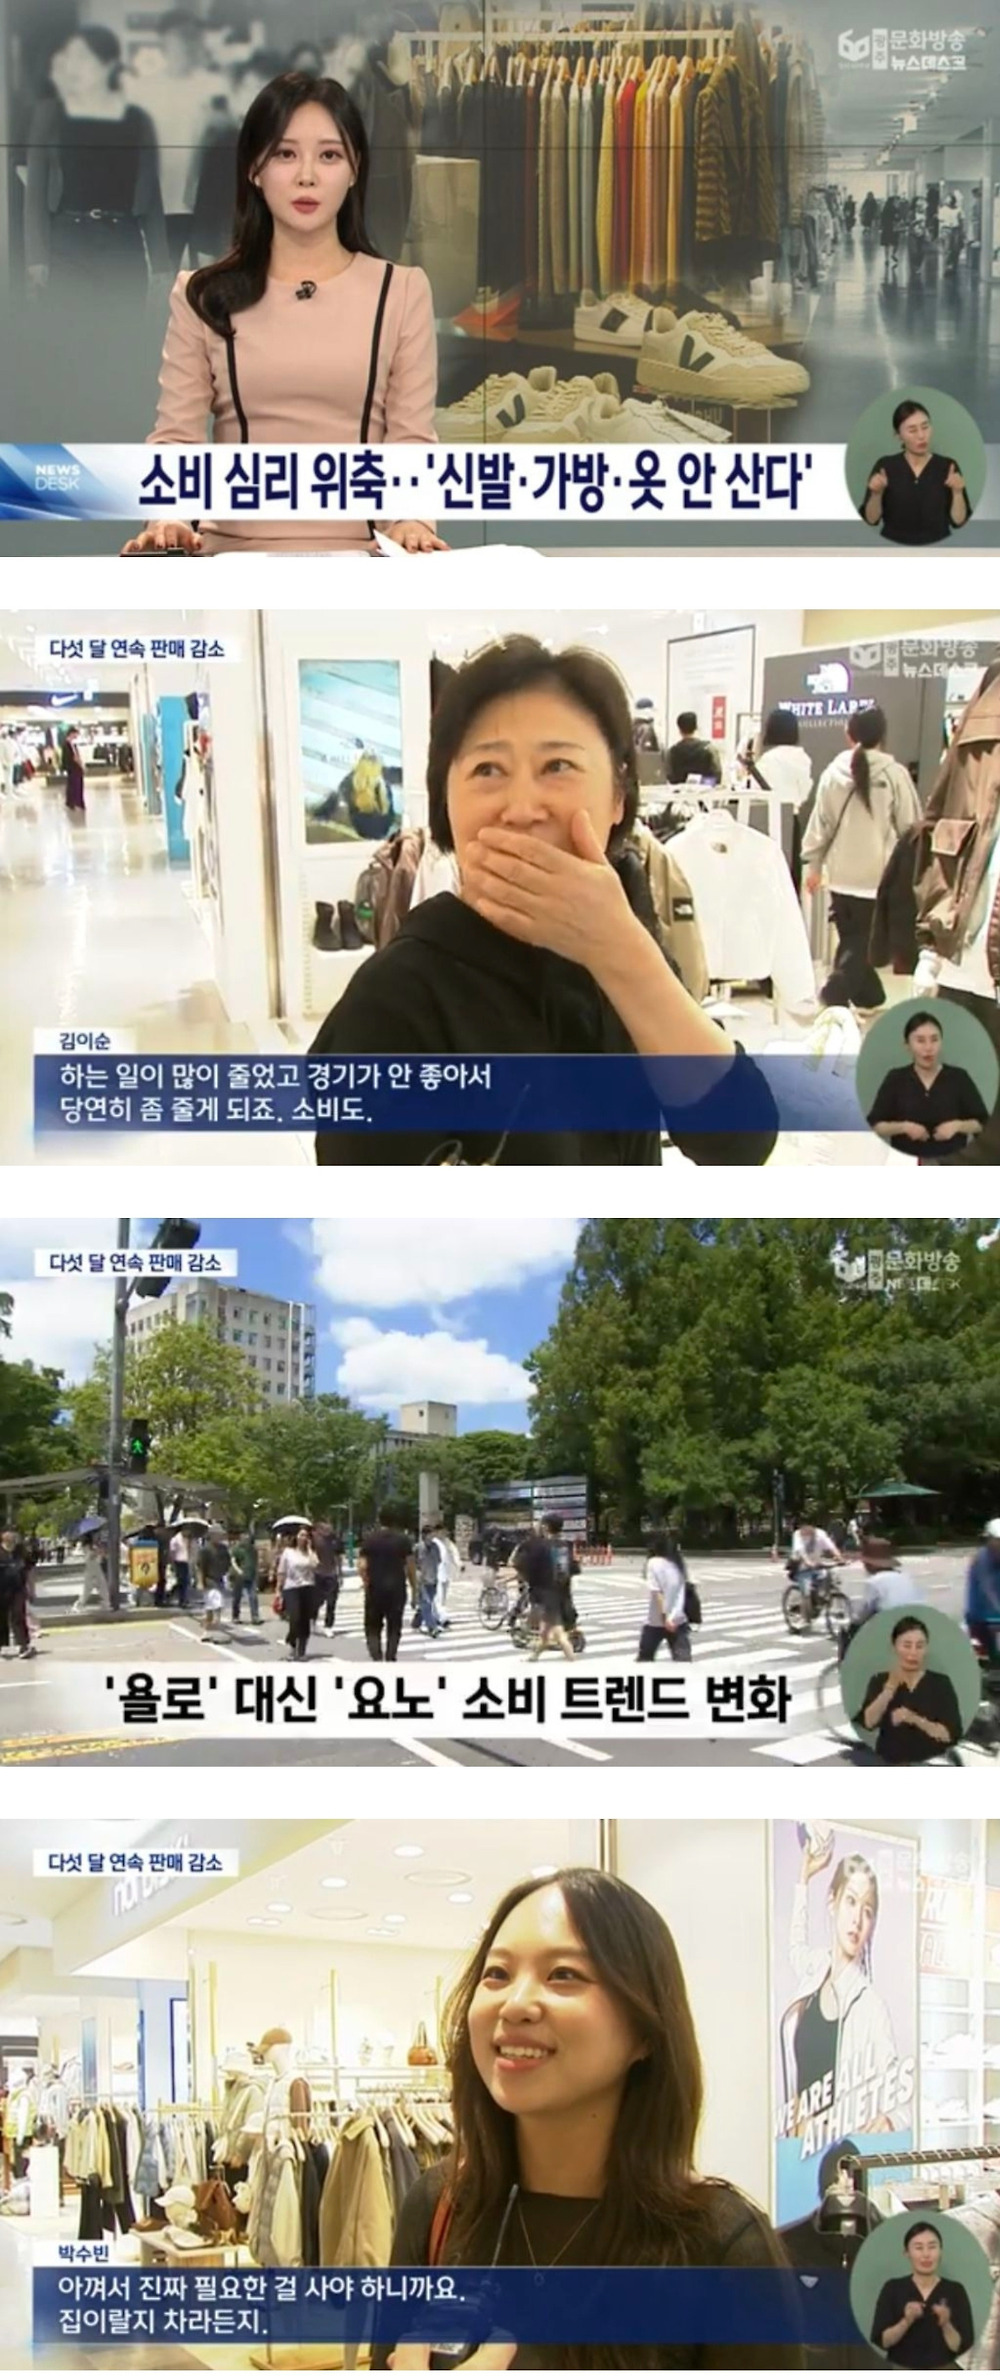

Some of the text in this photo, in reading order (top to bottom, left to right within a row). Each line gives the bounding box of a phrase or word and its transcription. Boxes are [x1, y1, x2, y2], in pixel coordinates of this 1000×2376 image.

[779, 701, 823, 716] WHITE
[798, 2069, 834, 2121] ARE
[834, 2038, 879, 2103] ALL
[800, 2056, 917, 2161] ATHLETES
